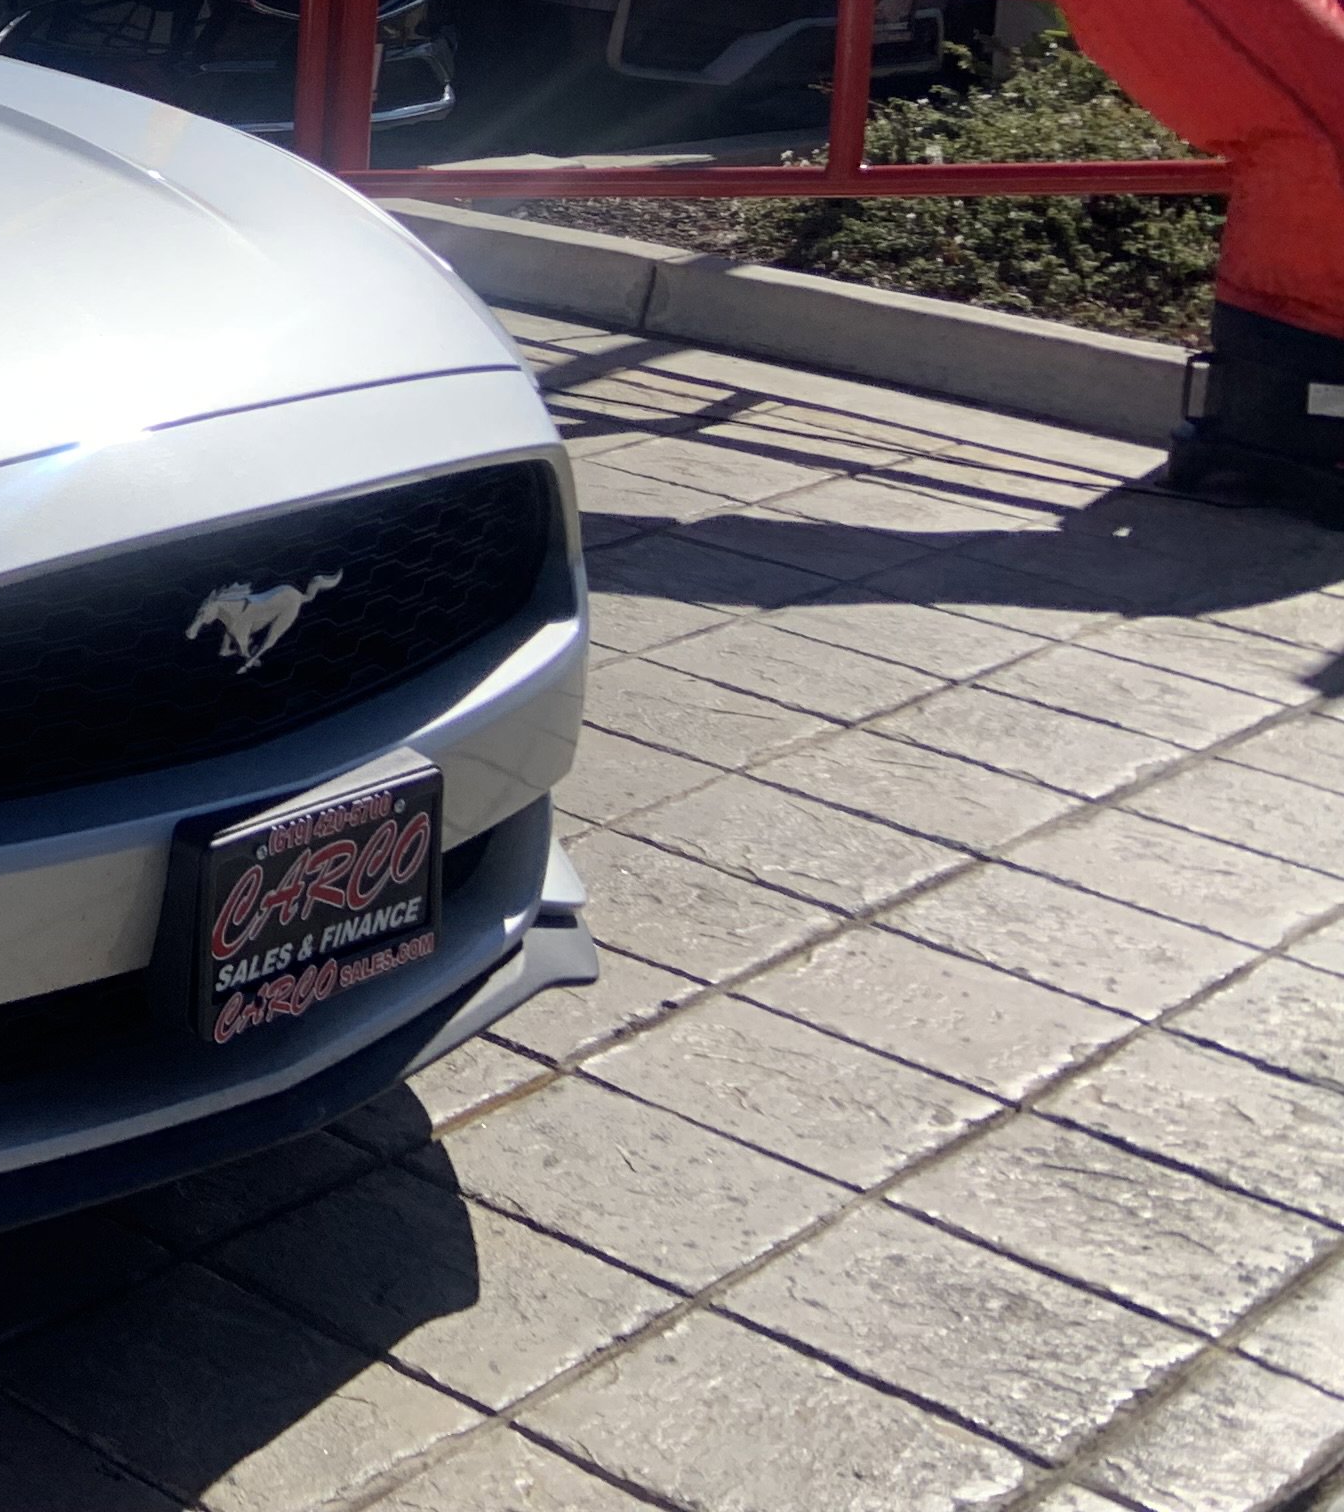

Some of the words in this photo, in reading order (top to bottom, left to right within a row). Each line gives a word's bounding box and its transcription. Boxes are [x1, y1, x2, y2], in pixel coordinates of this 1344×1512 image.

[211, 811, 431, 961] CARCO
[268, 815, 313, 856] (619)
[214, 958, 338, 1044] CARCO
[339, 932, 435, 987] SALES.COM
[215, 942, 293, 992] SALES
[297, 933, 314, 961] &
[320, 896, 423, 954] FINANCE
